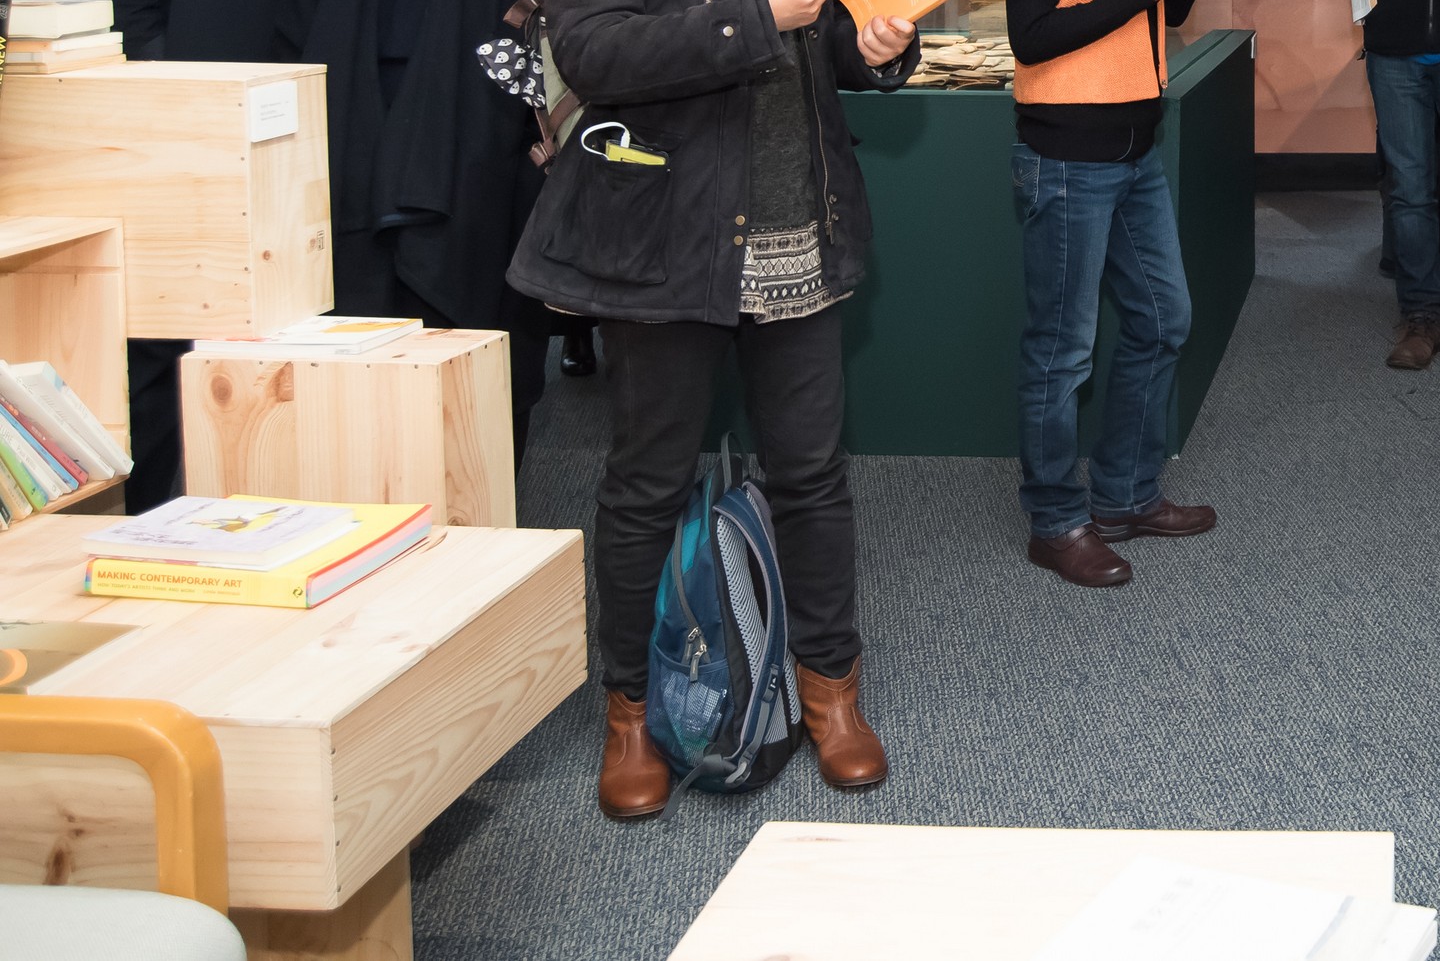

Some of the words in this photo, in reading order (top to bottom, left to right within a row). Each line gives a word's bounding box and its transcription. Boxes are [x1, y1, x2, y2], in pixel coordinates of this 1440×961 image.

[97, 570, 136, 580] MAKING
[139, 573, 220, 586] CONTEMPORARY
[223, 579, 243, 588] ART
